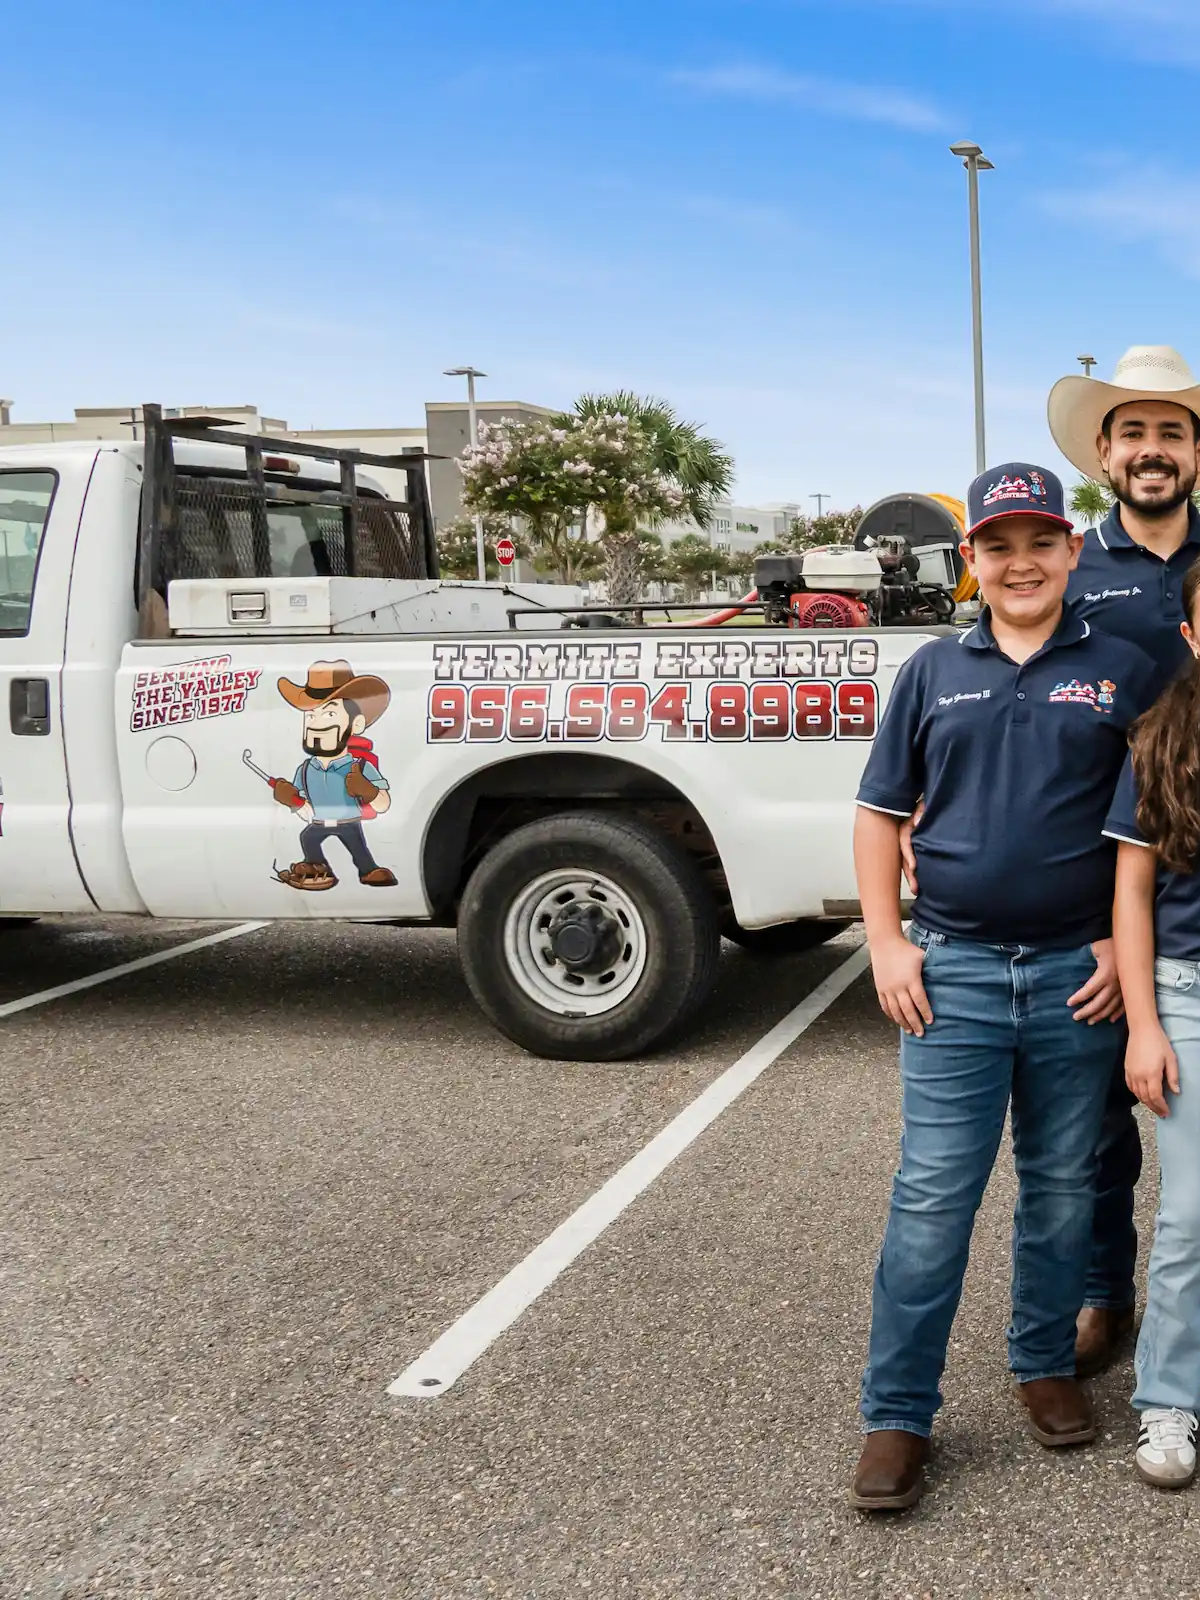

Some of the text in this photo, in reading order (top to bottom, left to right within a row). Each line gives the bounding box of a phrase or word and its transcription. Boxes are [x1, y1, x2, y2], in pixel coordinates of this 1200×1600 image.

[497, 547, 514, 558] STOP
[136, 656, 230, 688] SERVING
[433, 639, 879, 681] TERMITE EXPERTS
[135, 668, 263, 709] THE VALLEY
[982, 689, 991, 698] III
[132, 692, 245, 729] SINCE 1977
[427, 680, 880, 743] 956.584.8989
